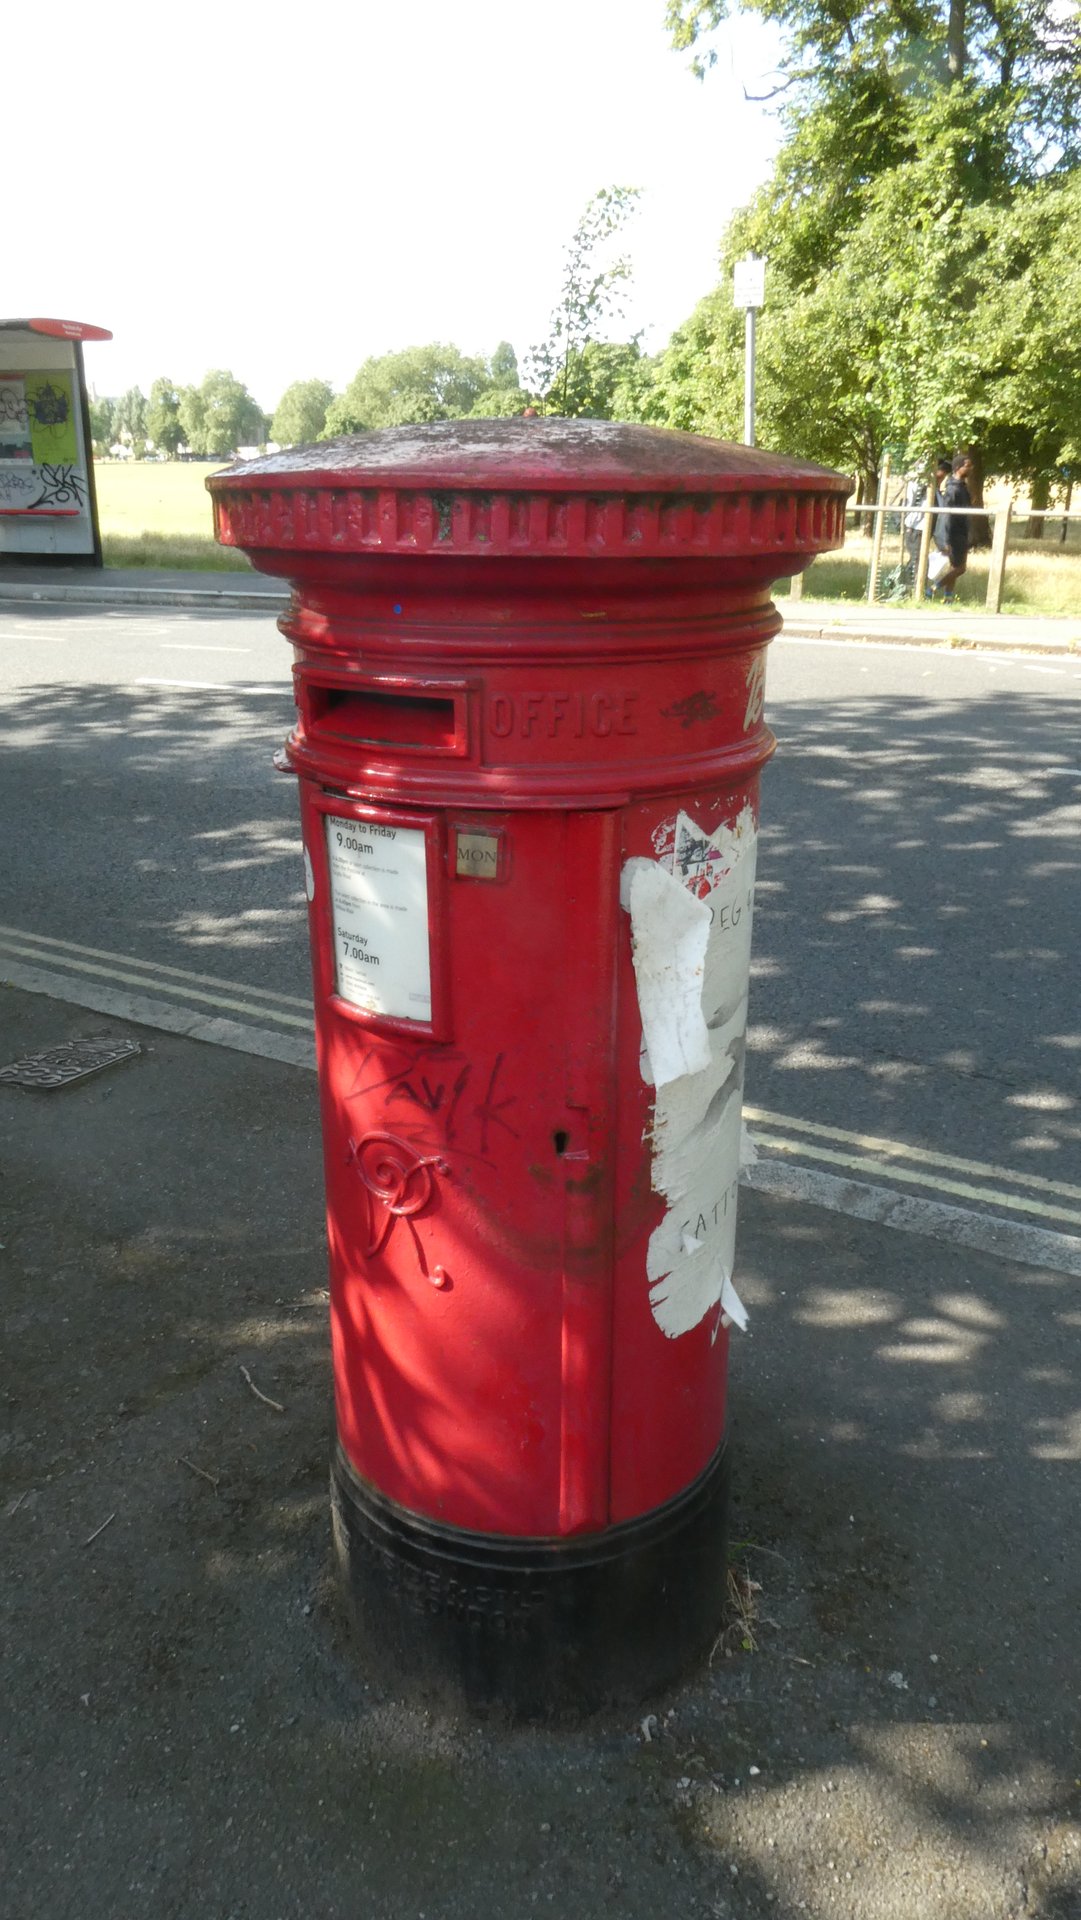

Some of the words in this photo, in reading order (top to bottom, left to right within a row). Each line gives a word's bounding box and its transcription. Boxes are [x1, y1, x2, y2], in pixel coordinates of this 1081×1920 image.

[489, 690, 640, 739] OFFICE
[329, 816, 357, 834] Monday
[358, 823, 367, 834] to
[369, 824, 397, 841] Friday
[336, 831, 374, 855] 9.00am
[457, 846, 498, 864] MON
[337, 926, 369, 947] Saturday
[343, 941, 380, 966] 7.00am
